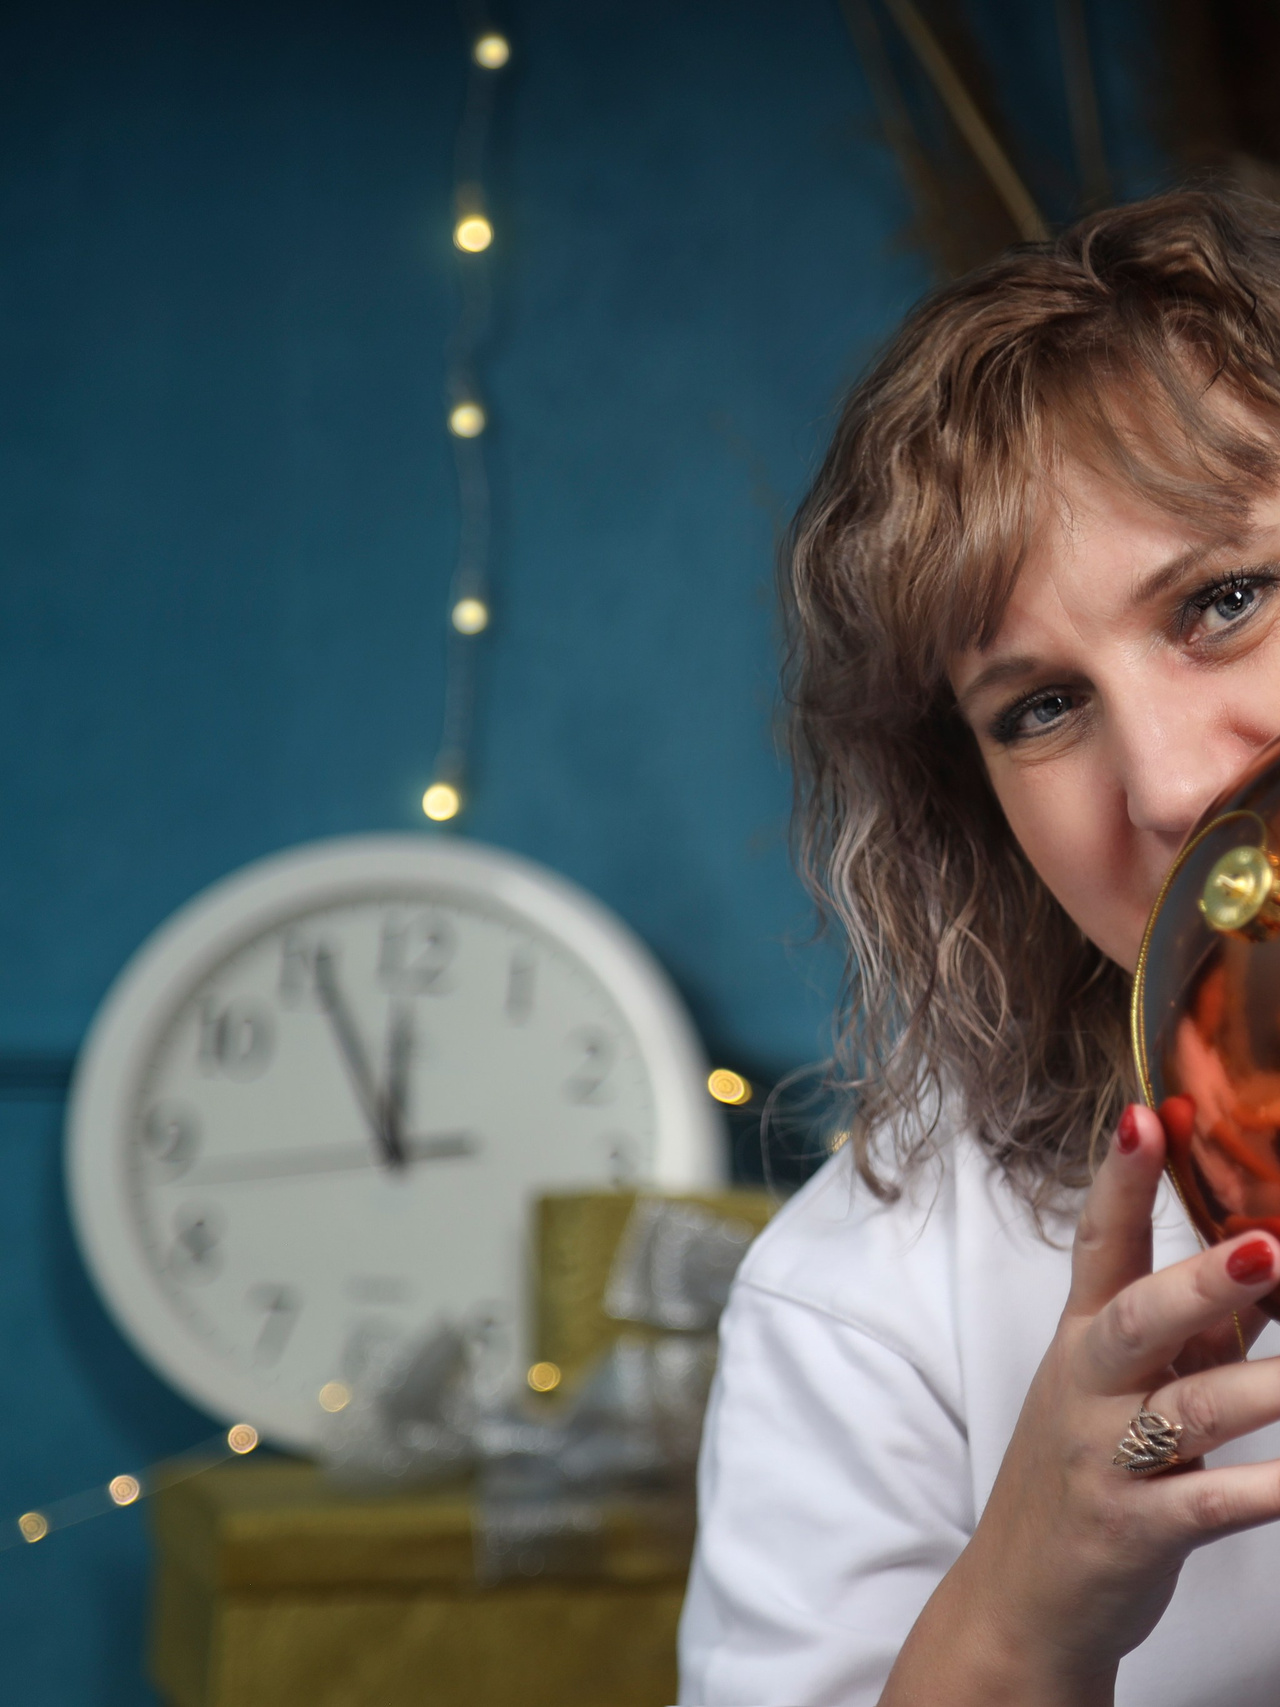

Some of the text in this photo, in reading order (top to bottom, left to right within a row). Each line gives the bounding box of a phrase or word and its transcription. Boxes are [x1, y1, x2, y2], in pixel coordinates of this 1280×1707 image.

[377, 907, 460, 997] 12
[506, 943, 538, 1028] 1
[199, 994, 277, 1083] 10
[560, 1022, 617, 1107] 2
[169, 1200, 228, 1288] 8
[243, 1281, 304, 1369] 7
